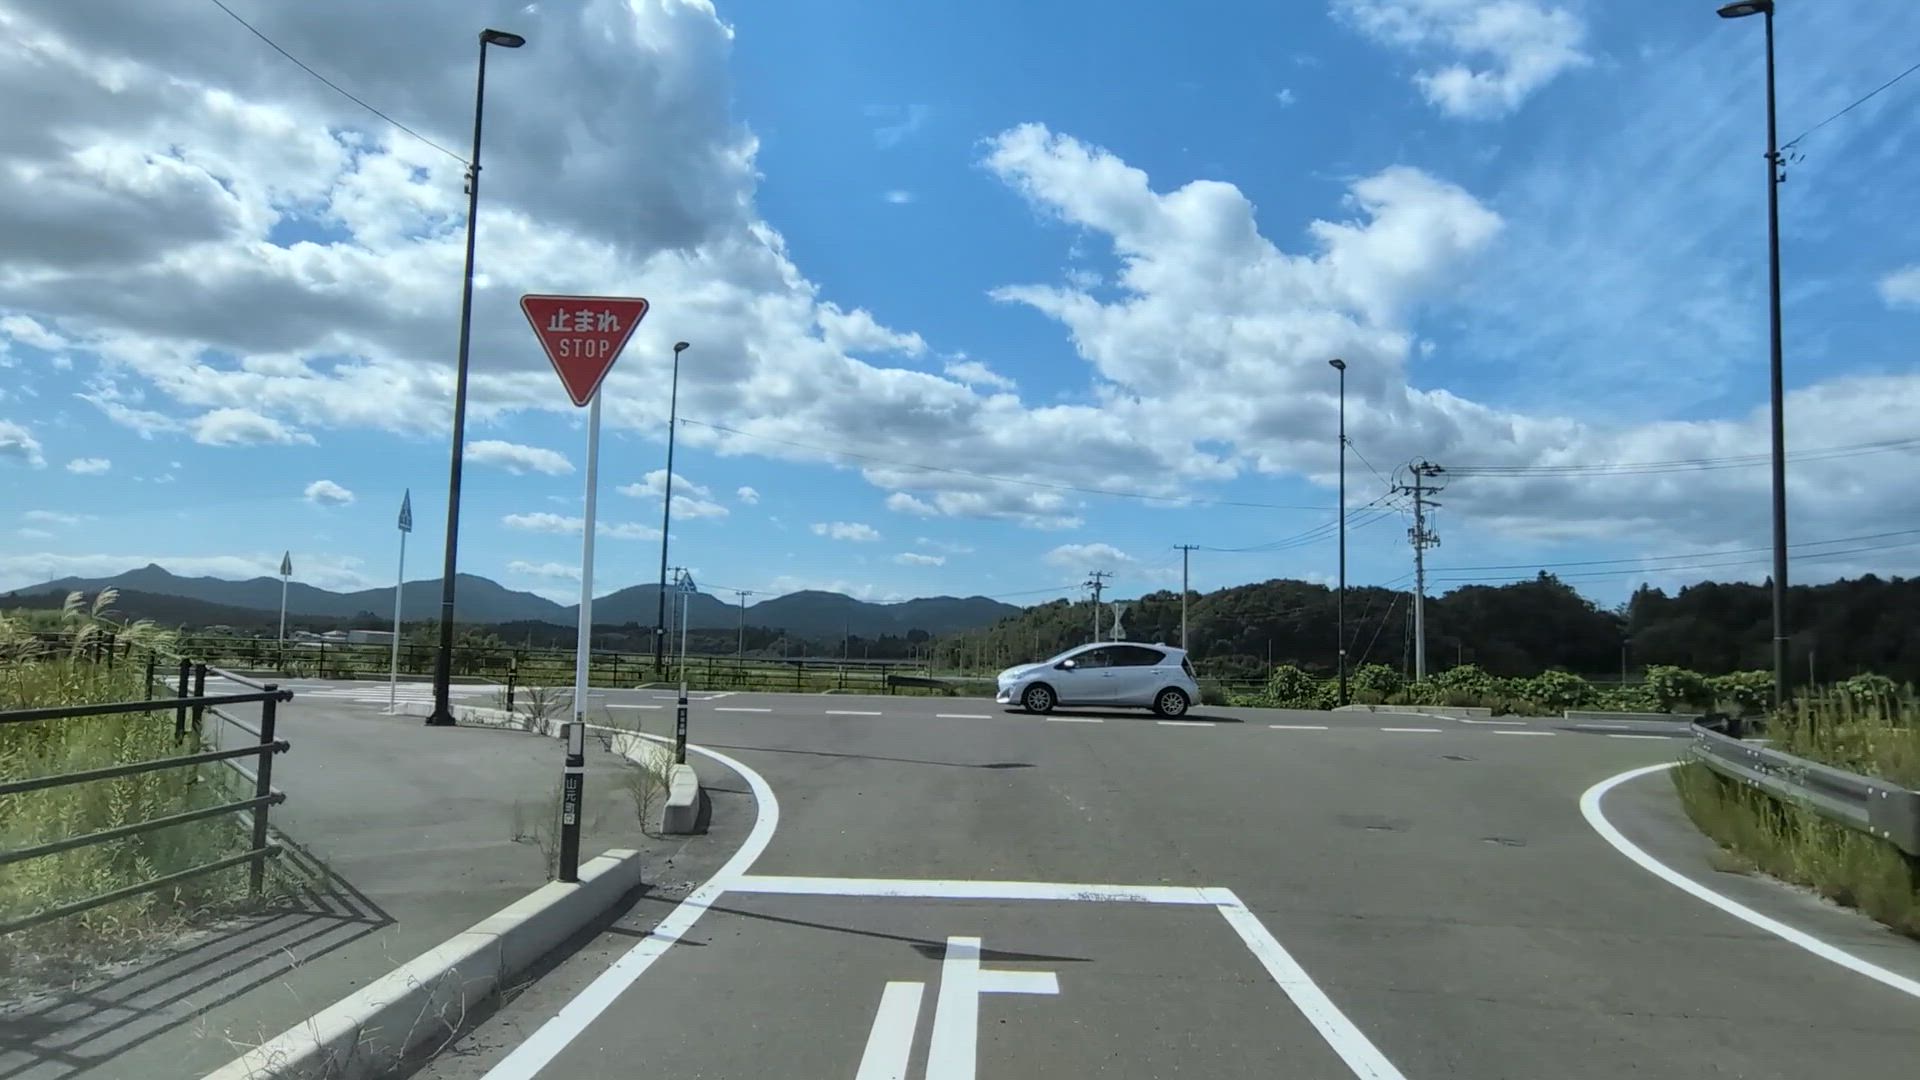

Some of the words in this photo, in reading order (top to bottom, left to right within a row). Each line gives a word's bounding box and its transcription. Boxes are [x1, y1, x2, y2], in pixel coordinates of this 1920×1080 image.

[548, 308, 621, 332] 止まれ
[559, 338, 609, 358] STOP
